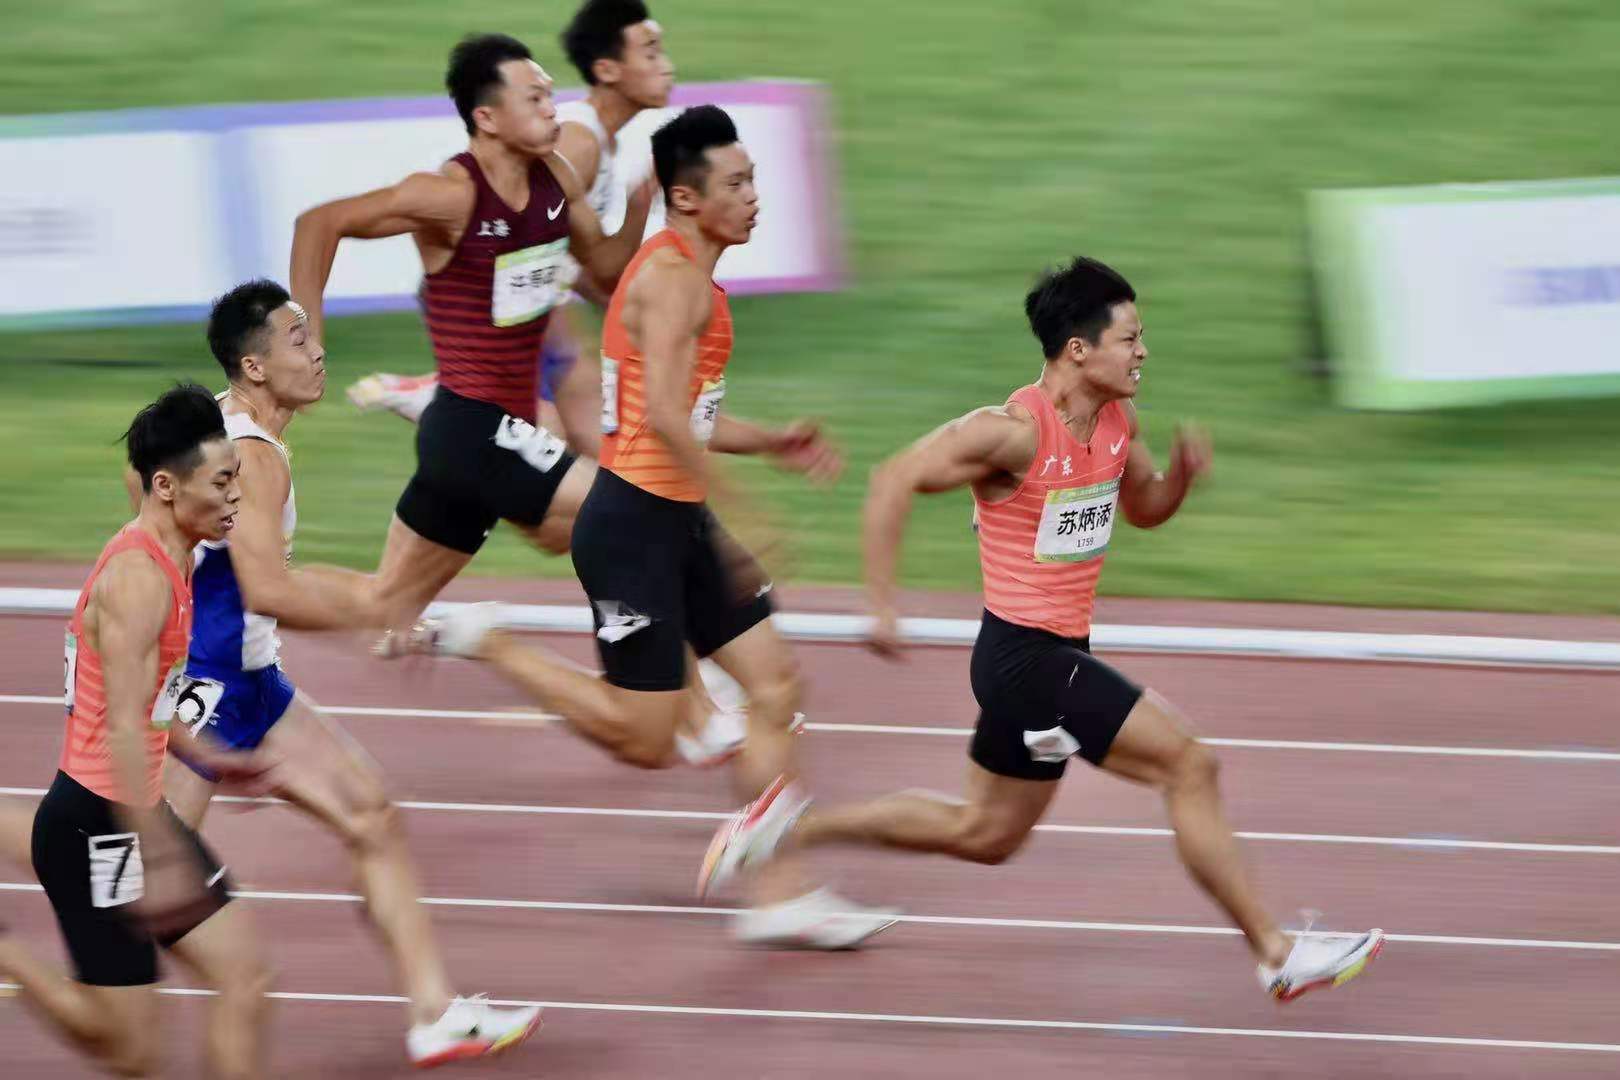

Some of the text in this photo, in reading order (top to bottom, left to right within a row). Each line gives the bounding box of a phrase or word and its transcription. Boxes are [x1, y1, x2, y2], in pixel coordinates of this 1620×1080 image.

[1057, 502, 1113, 535] 苏炳添
[1077, 537, 1094, 548] 1759
[95, 837, 135, 899] 7
